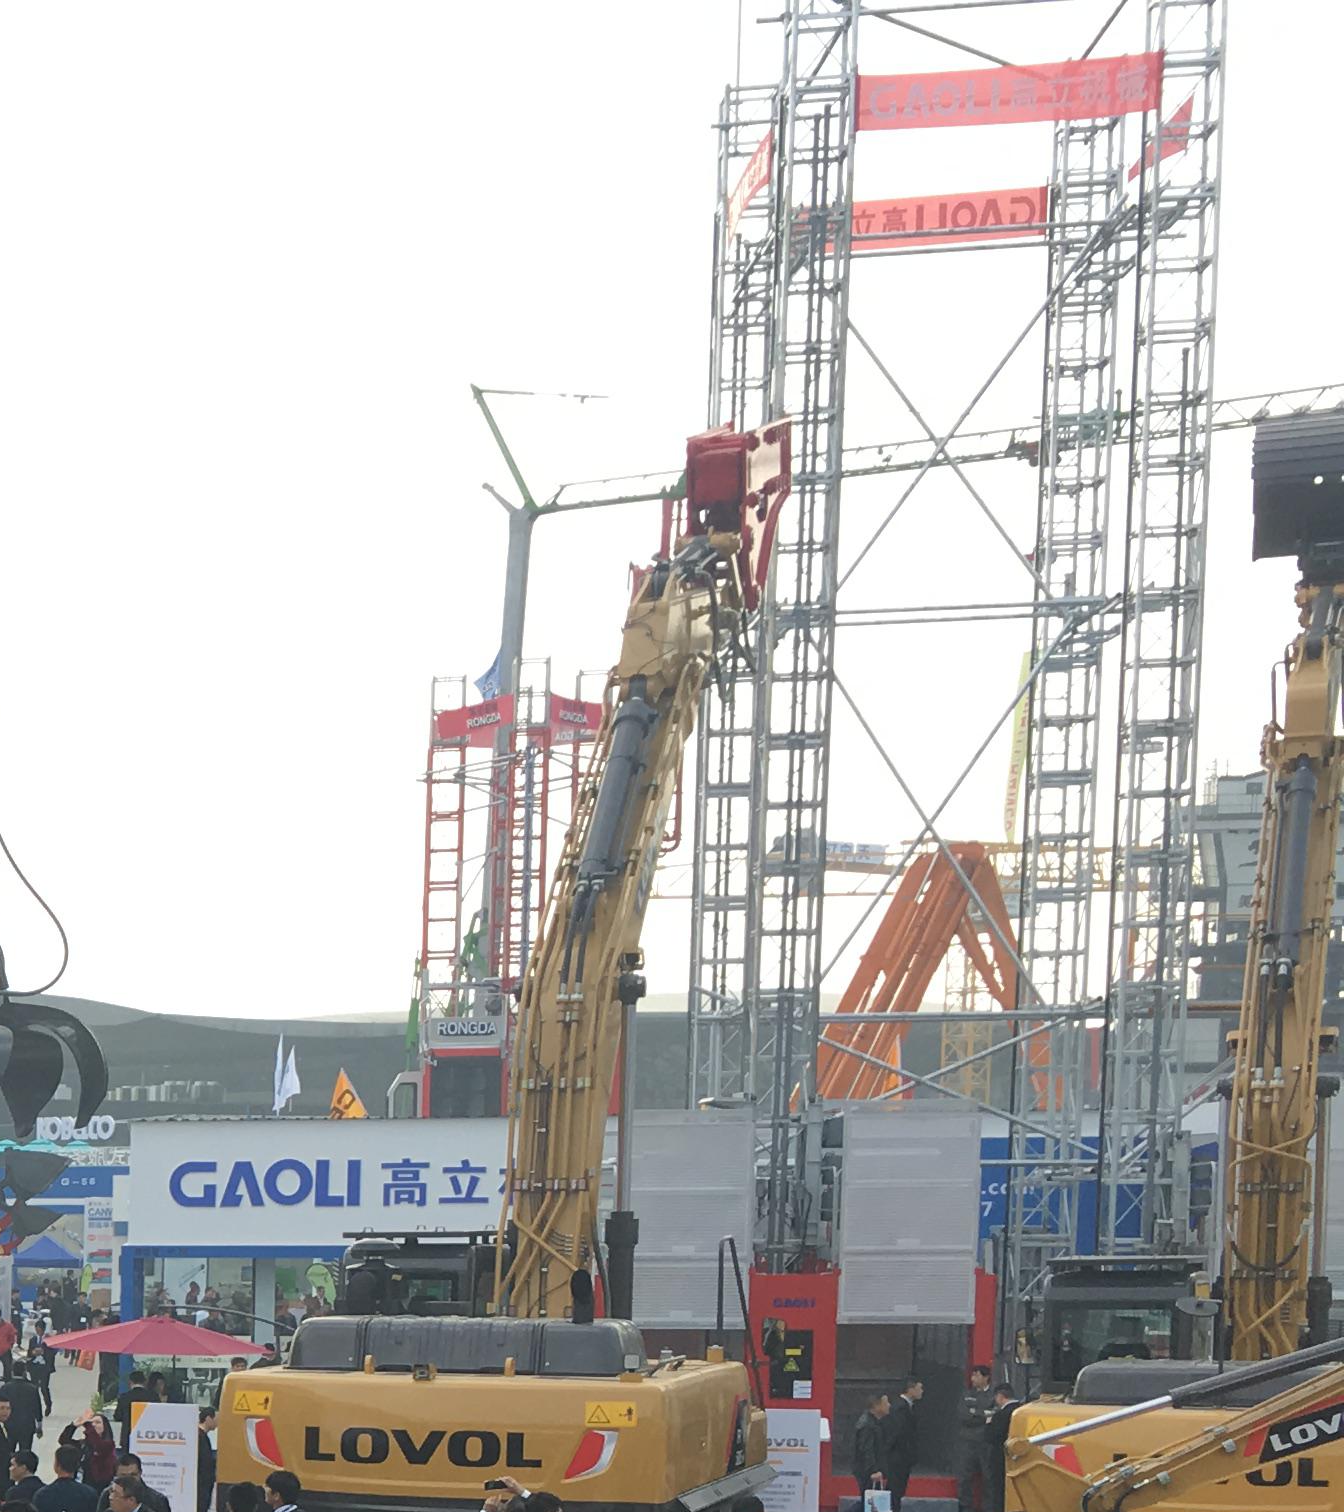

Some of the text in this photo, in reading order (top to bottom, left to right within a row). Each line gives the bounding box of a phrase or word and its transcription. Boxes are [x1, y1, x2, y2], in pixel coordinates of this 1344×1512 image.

[869, 78, 1001, 121] GAOLI
[466, 711, 501, 729] RONGDA
[437, 1021, 497, 1036] RONGDA
[169, 1158, 360, 1208] GAOLI
[136, 1430, 187, 1441] LOVOL
[305, 1426, 542, 1468] LOVOL
[1270, 1413, 1344, 1452] LOV
